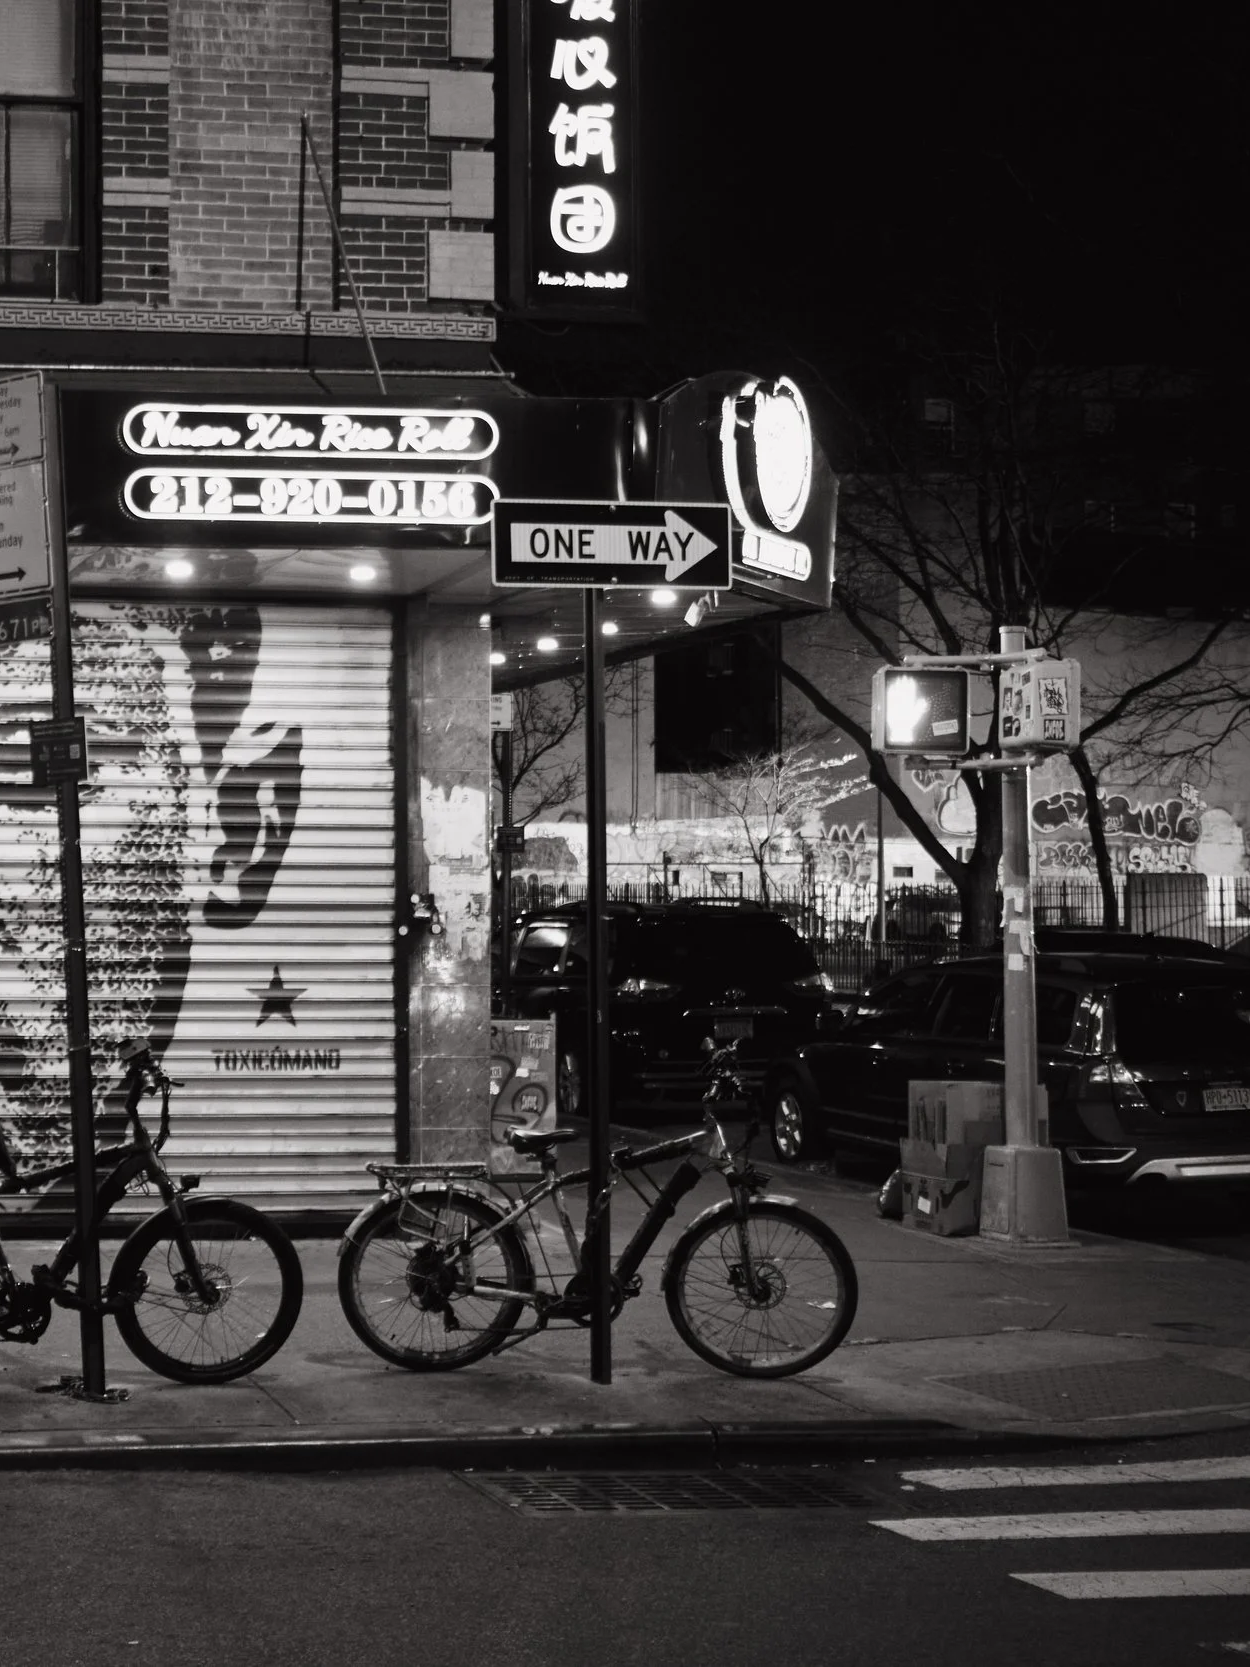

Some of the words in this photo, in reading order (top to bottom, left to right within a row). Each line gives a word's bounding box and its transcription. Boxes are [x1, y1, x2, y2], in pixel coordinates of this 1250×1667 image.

[549, 0, 617, 253] 心饭团
[141, 411, 241, 448] Nuan
[245, 413, 314, 450] Xin
[319, 415, 393, 452] Rice
[397, 417, 475, 453] Roll
[149, 476, 476, 518] 212-920-0156
[530, 528, 596, 559] ONE
[627, 530, 694, 561] WAY
